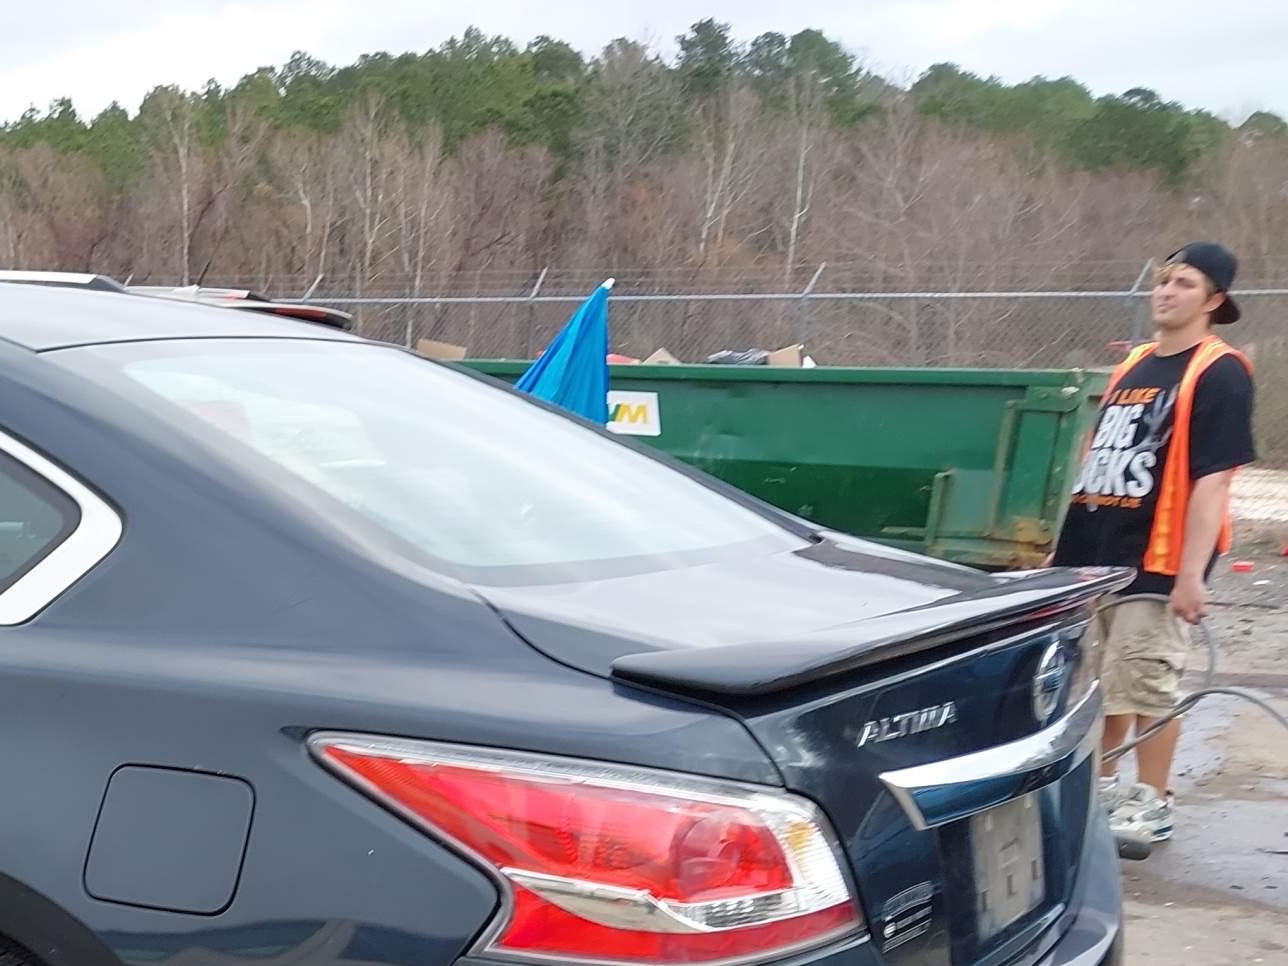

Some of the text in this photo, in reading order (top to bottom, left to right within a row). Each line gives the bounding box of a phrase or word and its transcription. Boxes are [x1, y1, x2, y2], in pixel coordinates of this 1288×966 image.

[1116, 387, 1161, 405] LIKE
[1091, 403, 1145, 450] BIG
[857, 701, 957, 748] ALTIMA
